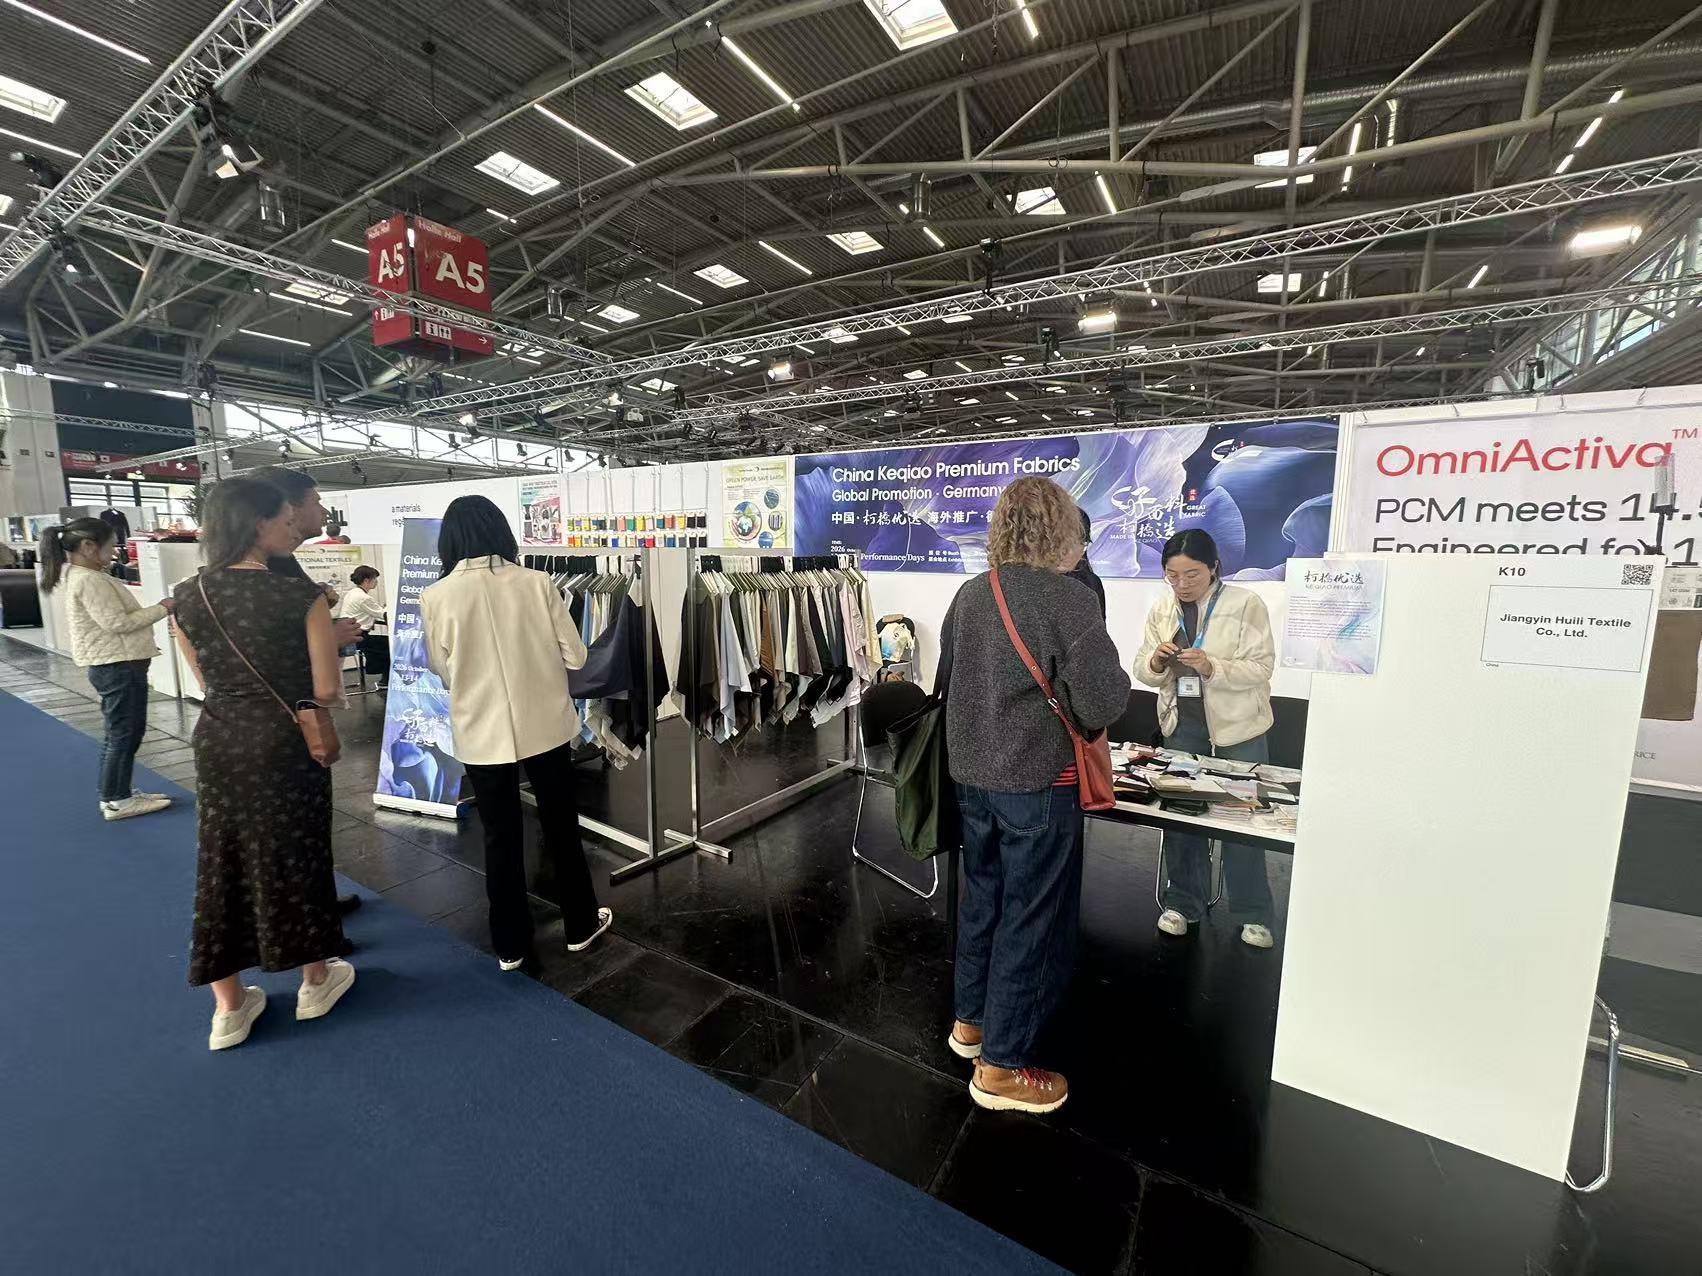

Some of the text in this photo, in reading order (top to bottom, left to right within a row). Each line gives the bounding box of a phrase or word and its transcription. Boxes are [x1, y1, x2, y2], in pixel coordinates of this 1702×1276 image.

[444, 231, 461, 242] Hall
[378, 242, 404, 283] A5
[435, 252, 485, 294] A5
[1376, 436, 1672, 476] OmniActiva
[832, 455, 1081, 484] China Keqiao Premium Fabrics
[832, 488, 869, 501] Global
[872, 486, 932, 500] Promotion
[1375, 493, 1702, 523] PCM meets 14.
[404, 555, 429, 566] China
[860, 553, 926, 563] Performance Days
[402, 568, 439, 579] Premium
[1498, 567, 1526, 577] K10
[401, 585, 424, 594] Global
[1500, 614, 1632, 628] Jiangyin Huili Textile
[1536, 627, 1588, 638] Co., Ltd.
